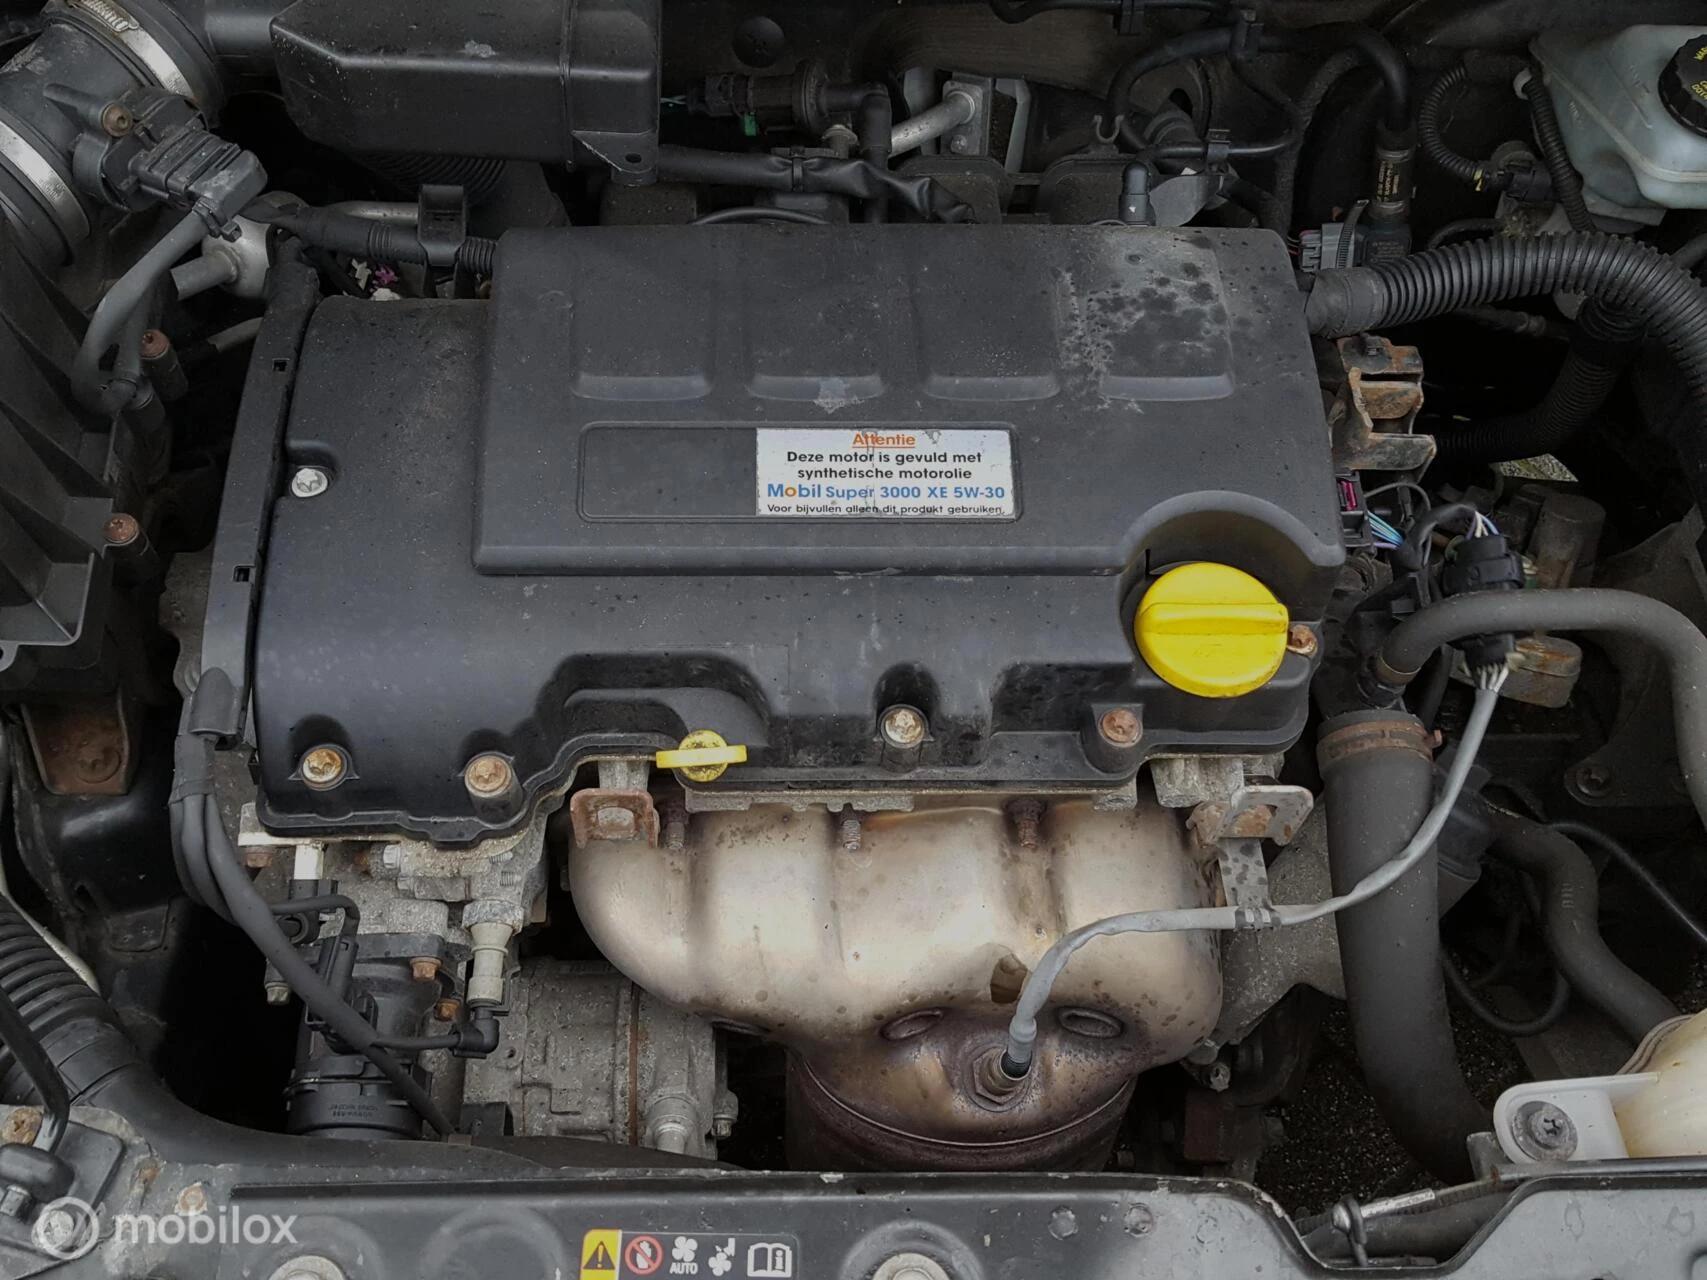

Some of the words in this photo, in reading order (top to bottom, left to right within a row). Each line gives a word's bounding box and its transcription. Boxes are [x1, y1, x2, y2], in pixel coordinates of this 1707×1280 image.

[852, 432, 916, 446] Attentie
[787, 451, 825, 464] Deze
[829, 452, 874, 464] motor
[879, 452, 891, 464] is
[895, 452, 948, 467] gevuld
[952, 452, 981, 464] met
[798, 467, 894, 480] synthetische
[899, 467, 972, 480] motorolie
[767, 483, 821, 498] Mobil
[826, 486, 875, 501] Super
[880, 486, 921, 498] 3000
[927, 487, 948, 498] XE
[954, 486, 1005, 499] 5W-30
[768, 504, 792, 513] Voor
[796, 504, 842, 516] bijvullen
[846, 504, 878, 514] alleen
[900, 505, 943, 517] produkt
[669, 1262, 698, 1275] AUTO
